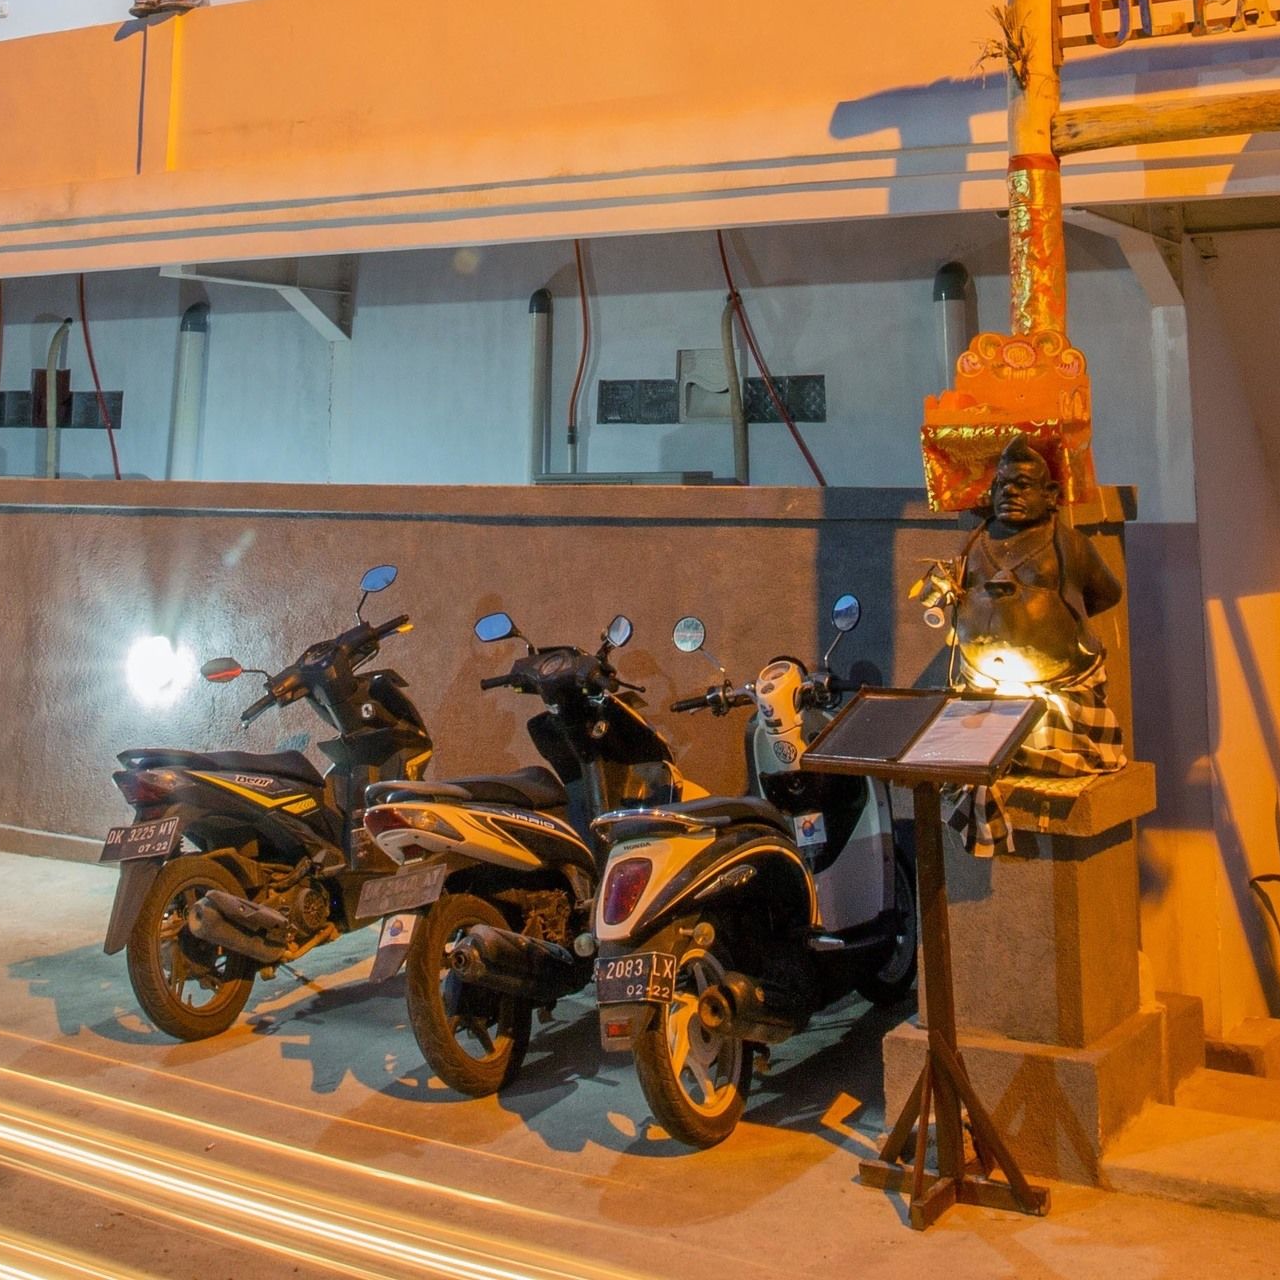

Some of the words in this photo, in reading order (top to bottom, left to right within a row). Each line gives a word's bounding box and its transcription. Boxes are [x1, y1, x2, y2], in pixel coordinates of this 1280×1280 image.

[106, 829, 125, 845] DK
[127, 825, 157, 842] 3225
[623, 841, 652, 851] HONDA
[606, 958, 643, 980] 2083
